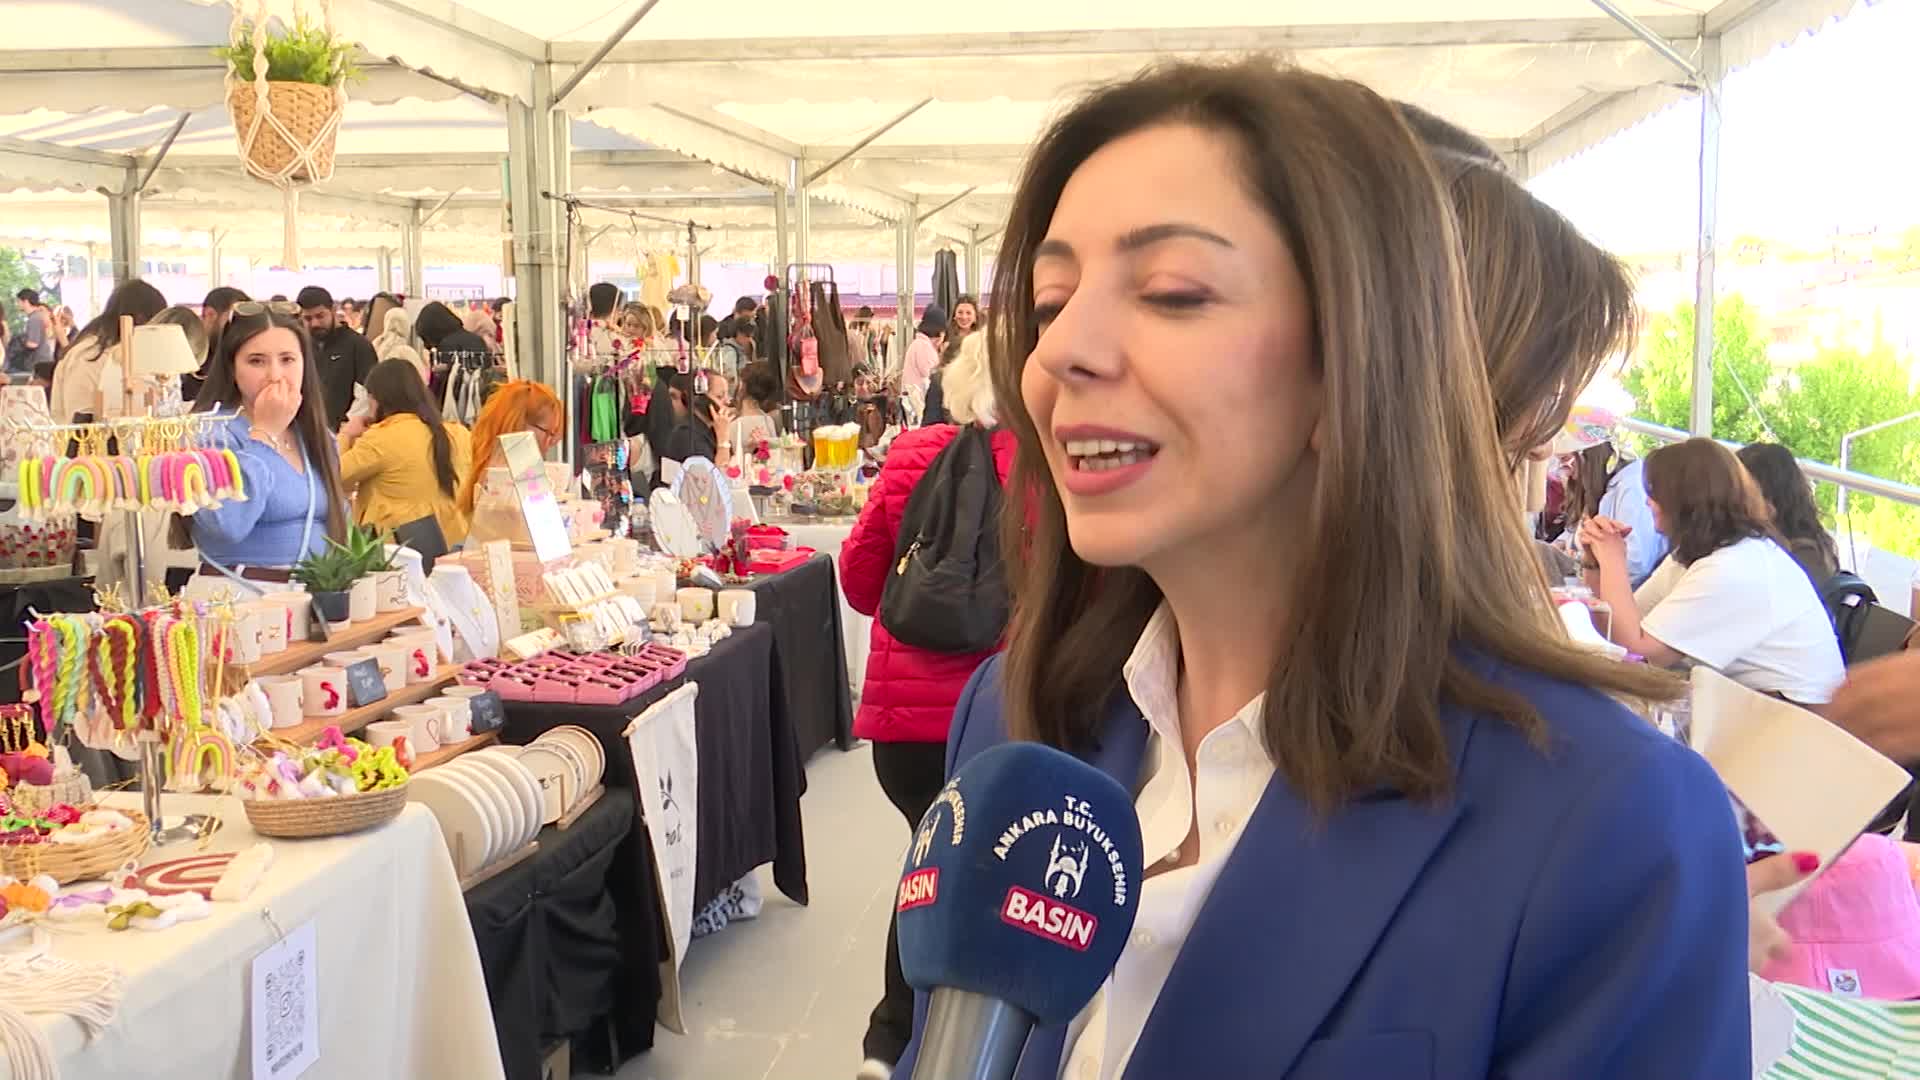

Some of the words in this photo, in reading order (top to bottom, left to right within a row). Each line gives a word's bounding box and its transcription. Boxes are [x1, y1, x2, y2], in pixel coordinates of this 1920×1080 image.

[1064, 795, 1093, 818] T.C.
[993, 809, 1058, 861] ANKARA
[1006, 891, 1093, 945] BASIN
